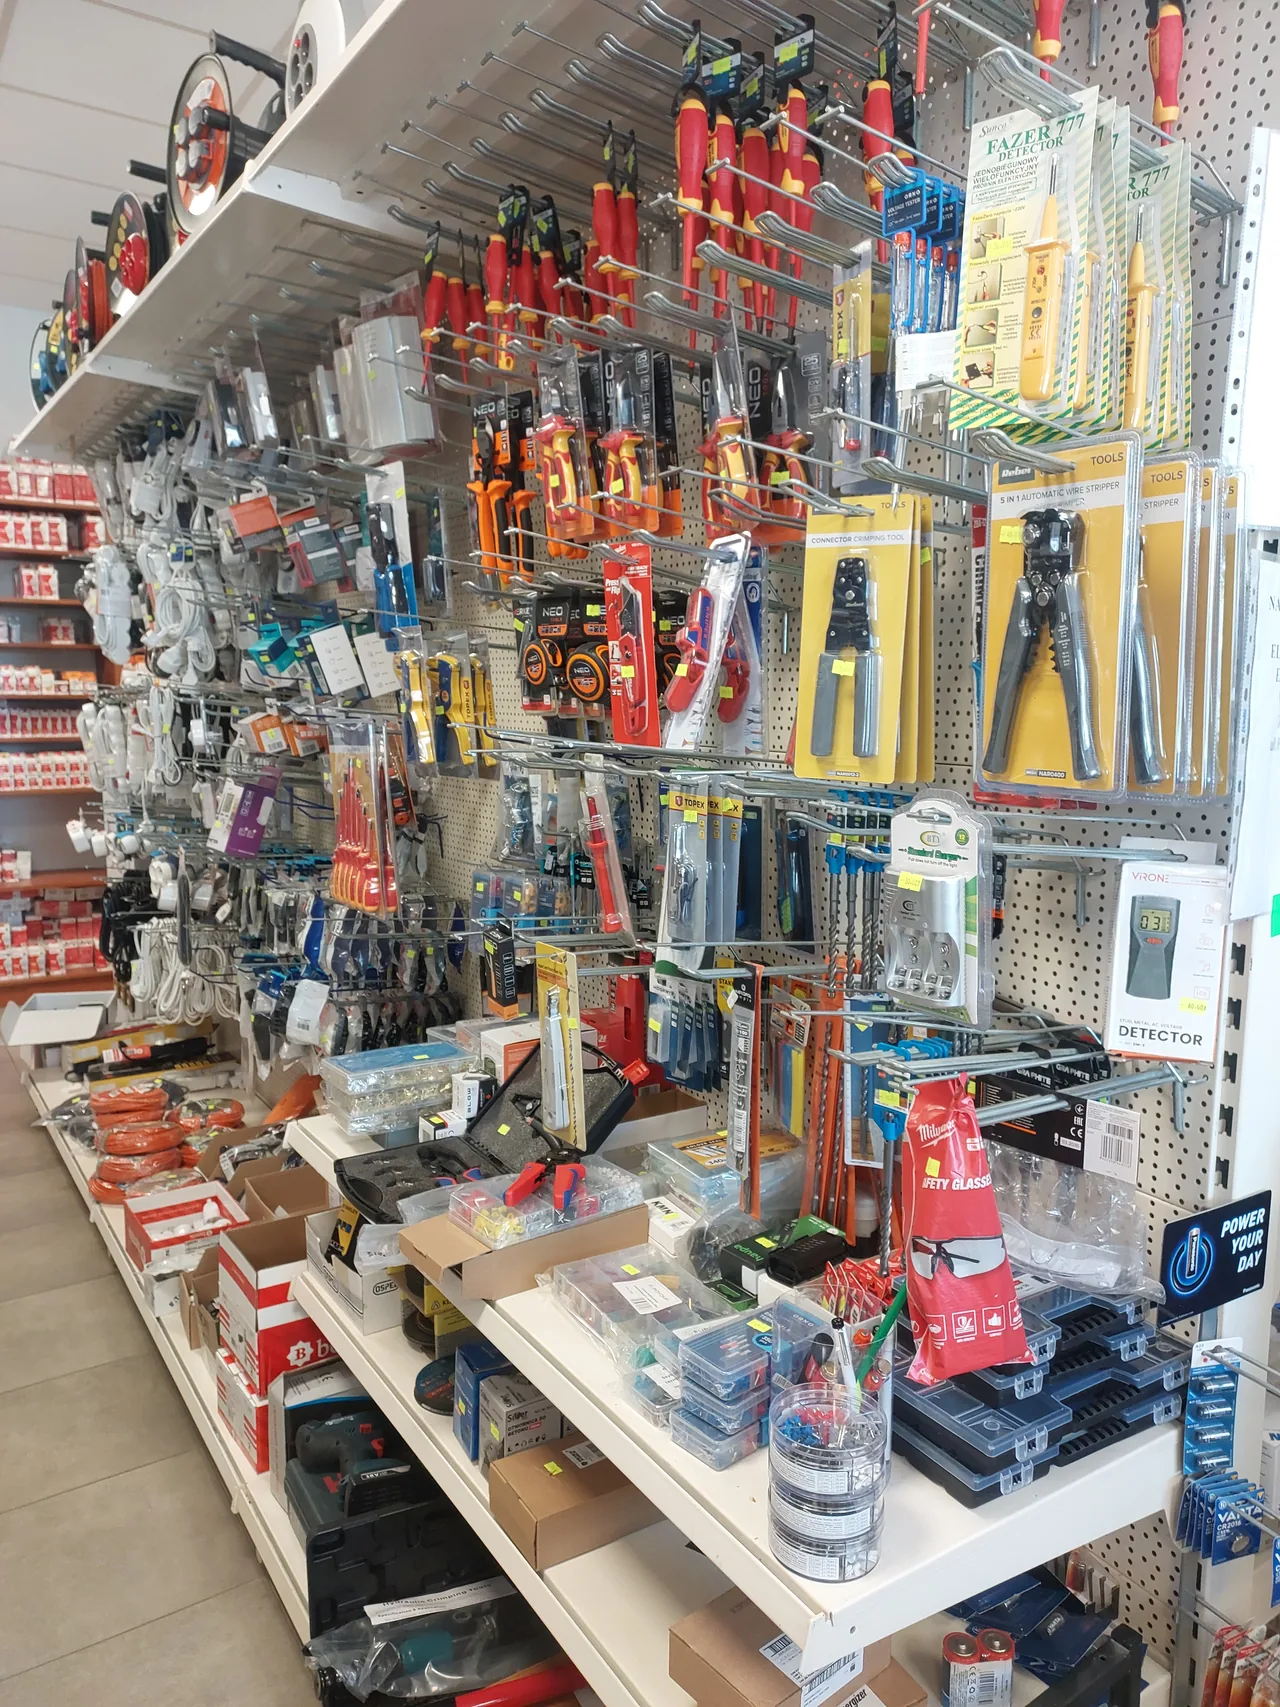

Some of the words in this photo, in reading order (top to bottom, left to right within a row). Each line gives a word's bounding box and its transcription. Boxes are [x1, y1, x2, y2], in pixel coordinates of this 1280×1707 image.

[986, 125, 1051, 155] FAZER
[1056, 113, 1086, 136] 777
[998, 136, 1063, 162] DETECTOR
[973, 156, 1039, 178] JEDNOBIEGUNOWY
[973, 163, 1039, 184] WIELOFUNKCYJNY
[1142, 165, 1171, 187] 777
[749, 367, 760, 418] NEO
[473, 401, 495, 417] NEO
[1091, 452, 1124, 466] TOOLS
[1150, 470, 1183, 483] TOOLS
[1007, 495, 1015, 503] IN
[1016, 494, 1021, 502] 1
[1021, 488, 1065, 501] AUTOMATIC
[1065, 485, 1084, 496] WIRE
[1085, 481, 1120, 493] STRIPPER
[1144, 498, 1179, 510] STRIPPER
[811, 536, 853, 544] CONNECTOR
[887, 533, 905, 541] TOOL
[605, 579, 619, 587] Press
[611, 586, 621, 595] Flip
[542, 606, 563, 617] NEO
[573, 666, 590, 674] NEO
[684, 798, 705, 809] TOPEX
[1119, 1025, 1203, 1046] DETECTOR
[1016, 1068, 1052, 1085] GRAPHITE
[1055, 1063, 1090, 1080] GRAPHITE
[1220, 1207, 1265, 1238] POWER
[1231, 1228, 1264, 1255] YOUR
[1237, 1248, 1263, 1274] DAY
[1217, 1520, 1242, 1531] CR2016
[427, 1590, 467, 1603] Crimping
[468, 1583, 493, 1593] Tools
